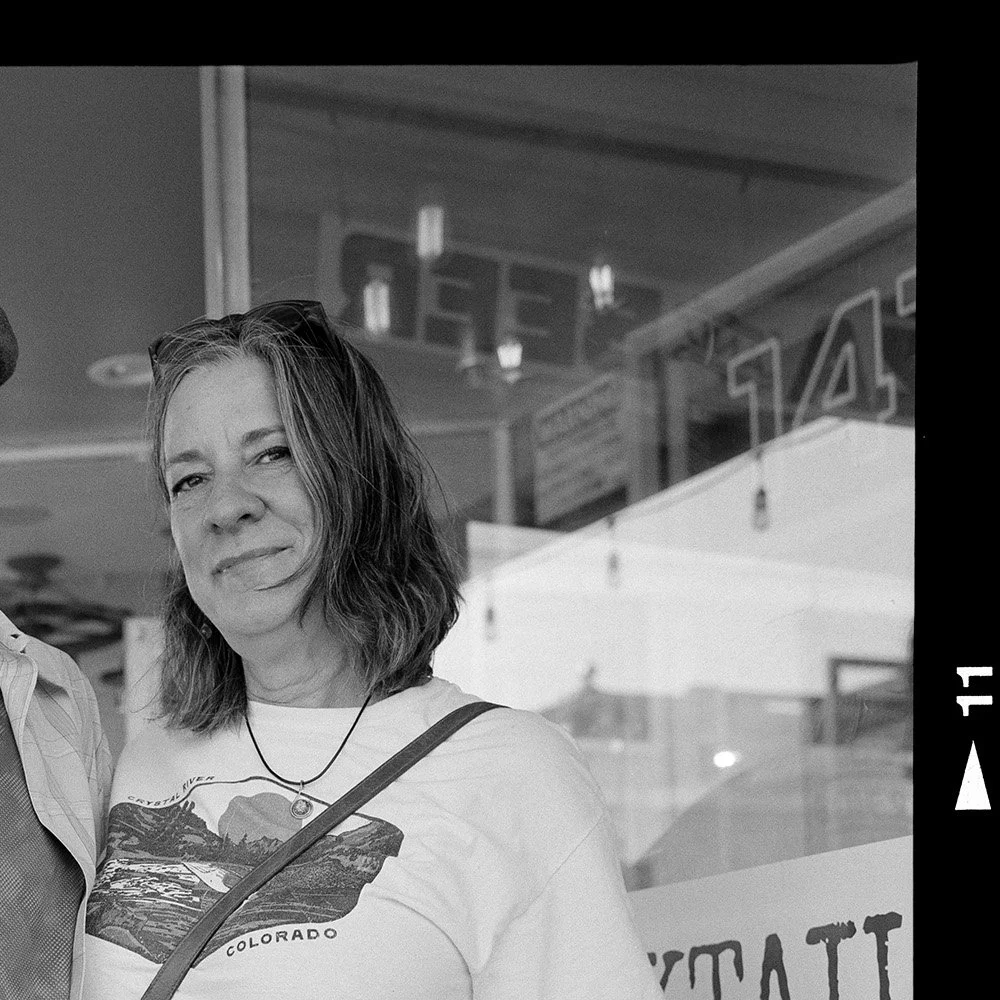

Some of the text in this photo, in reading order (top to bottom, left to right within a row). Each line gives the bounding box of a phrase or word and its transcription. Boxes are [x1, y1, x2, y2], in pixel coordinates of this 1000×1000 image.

[127, 775, 216, 807] CRYSTAL RIVER
[226, 928, 338, 957] COLORADO
